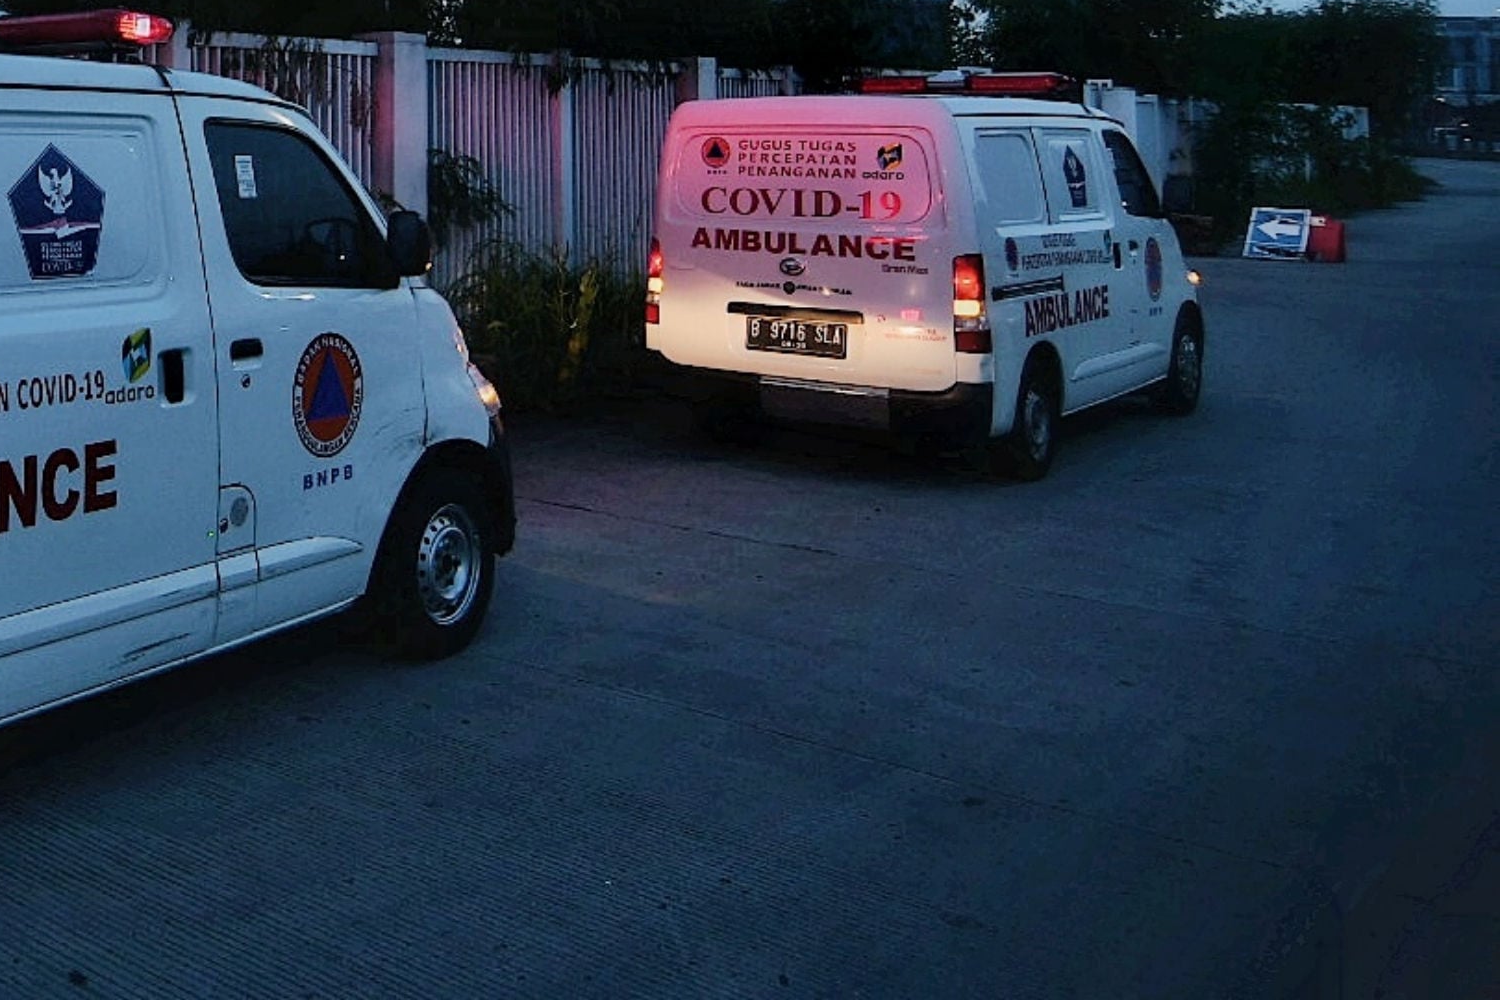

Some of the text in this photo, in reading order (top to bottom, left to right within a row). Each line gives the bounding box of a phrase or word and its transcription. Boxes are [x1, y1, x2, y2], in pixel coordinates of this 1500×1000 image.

[738, 140, 856, 153] GUGUS TUGAS
[738, 153, 856, 165] PERCEPATAN
[738, 165, 856, 179] PENANGANAN
[701, 186, 902, 219] COVID-19
[691, 227, 917, 262] AMBULANCE
[1023, 285, 1110, 338] AMBULANCE
[751, 319, 841, 345] B 9716 SLA
[17, 369, 105, 410] COVID-19
[105, 384, 155, 405] adaro
[302, 463, 354, 491] BNPB
